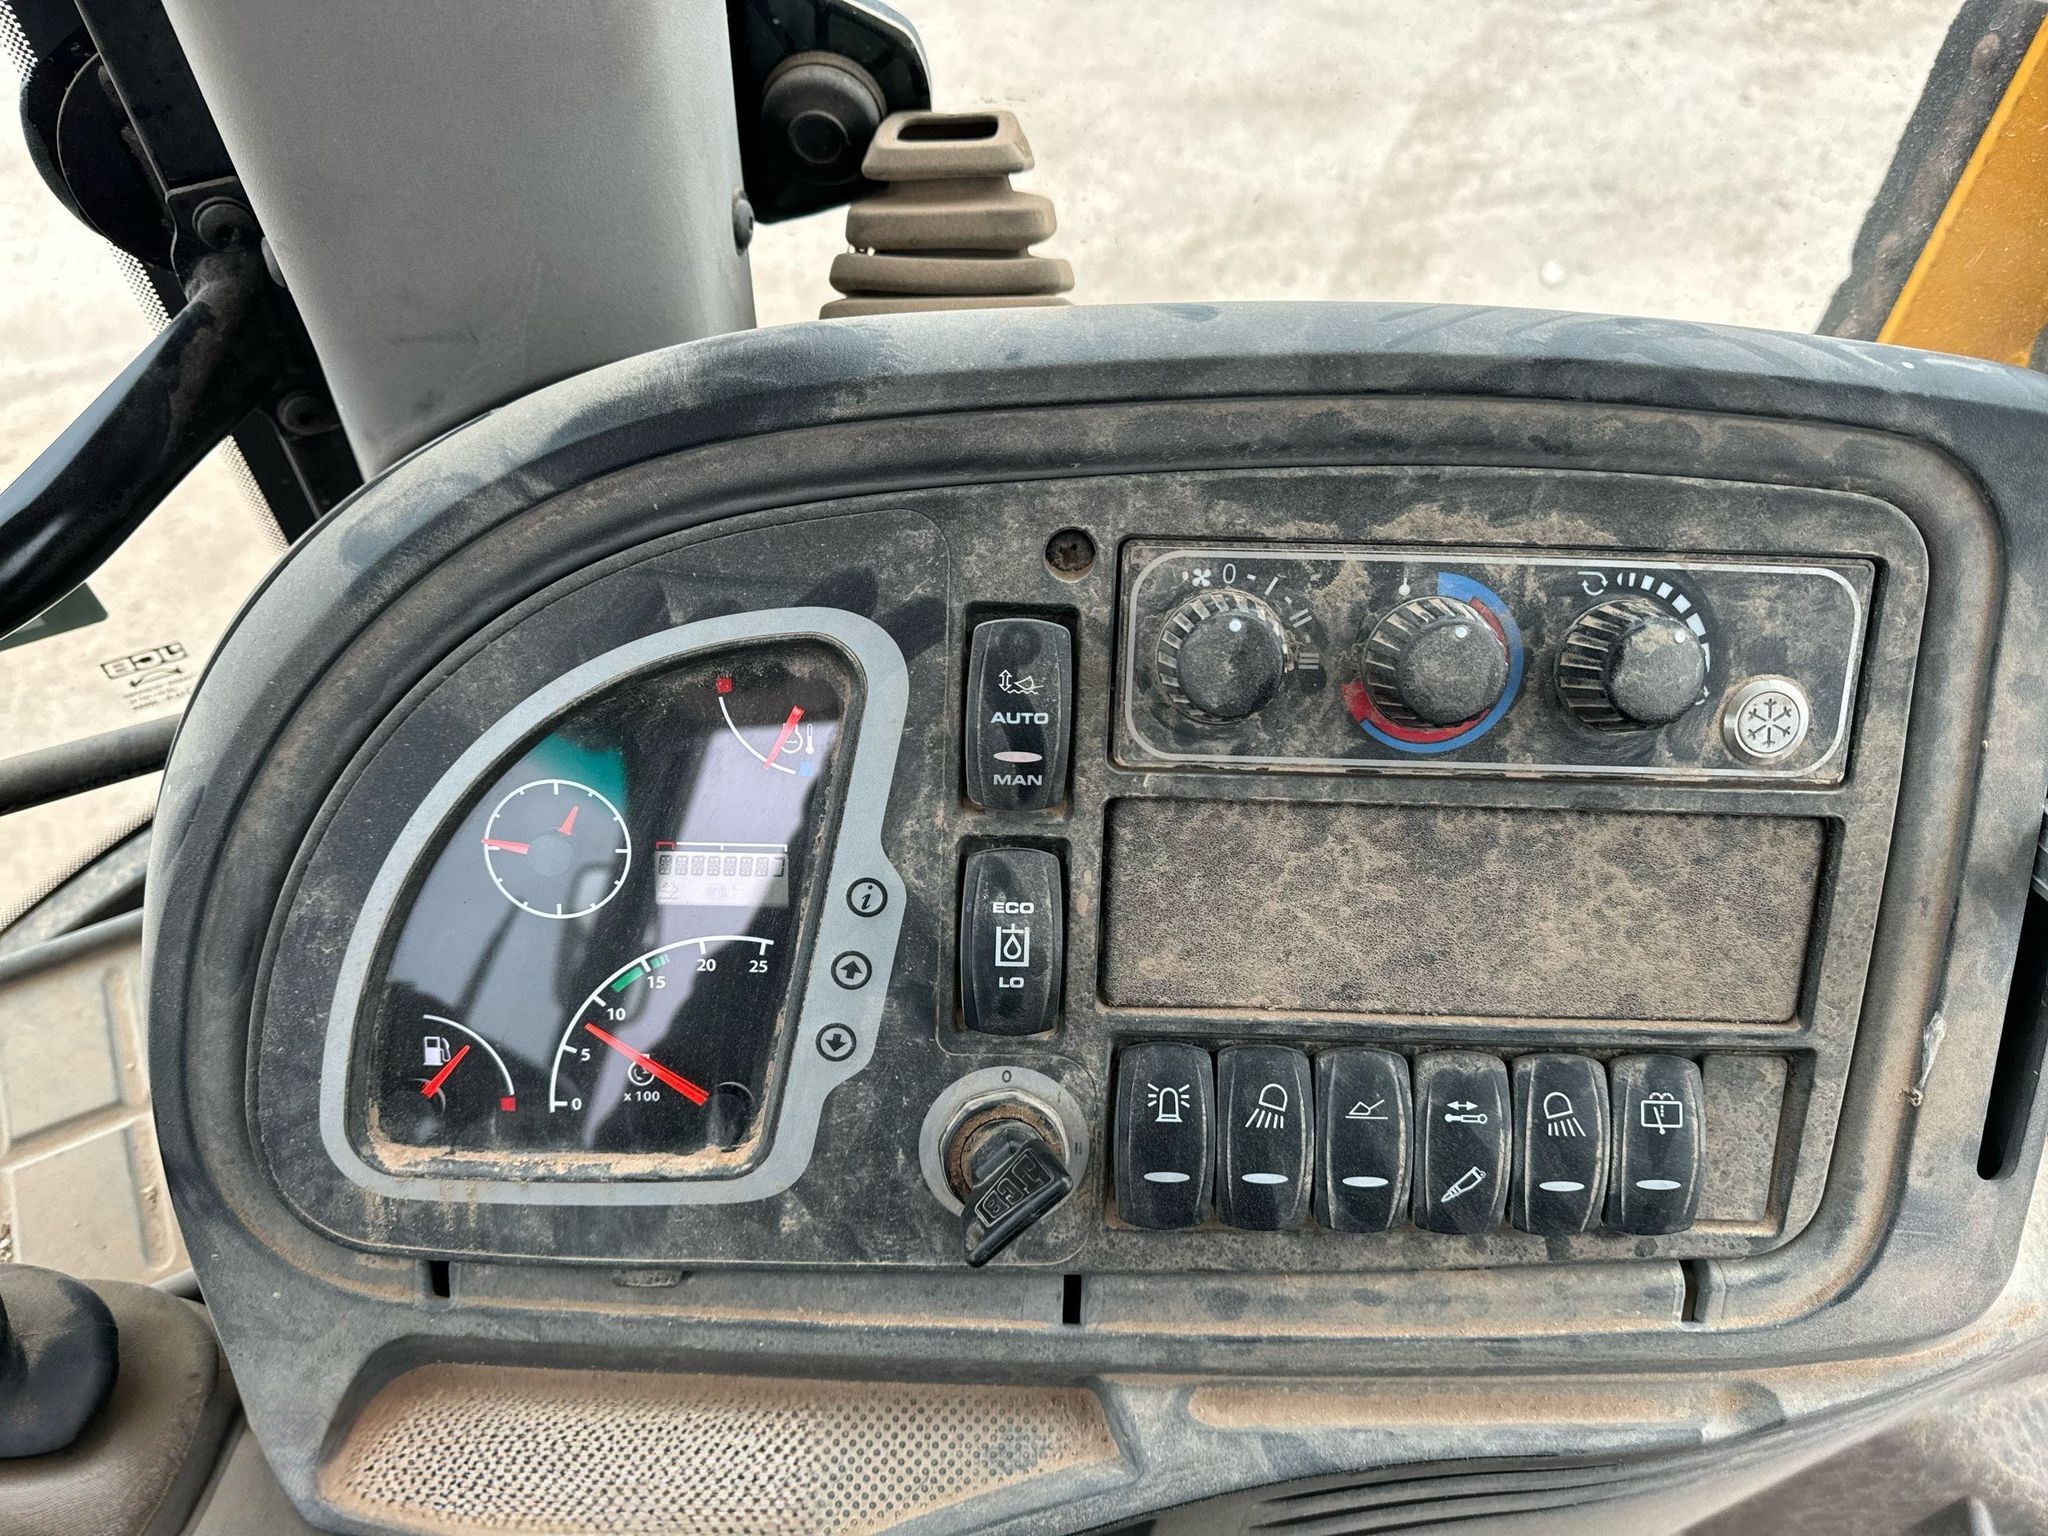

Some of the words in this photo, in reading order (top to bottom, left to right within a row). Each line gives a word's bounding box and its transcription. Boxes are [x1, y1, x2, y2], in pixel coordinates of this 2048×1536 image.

[990, 711, 1049, 725] AUTO
[993, 774, 1043, 786] MAN
[992, 901, 1035, 914] ECO
[696, 958, 717, 972] 20
[749, 960, 769, 974] 25
[647, 975, 667, 989] 15
[998, 976, 1025, 989] LO
[607, 1007, 626, 1021] 10
[580, 1048, 592, 1062] 5
[1001, 1069, 1013, 1083] 0
[637, 1090, 660, 1102] 100
[571, 1098, 582, 1111] 0
[980, 1152, 1046, 1220] JCB
